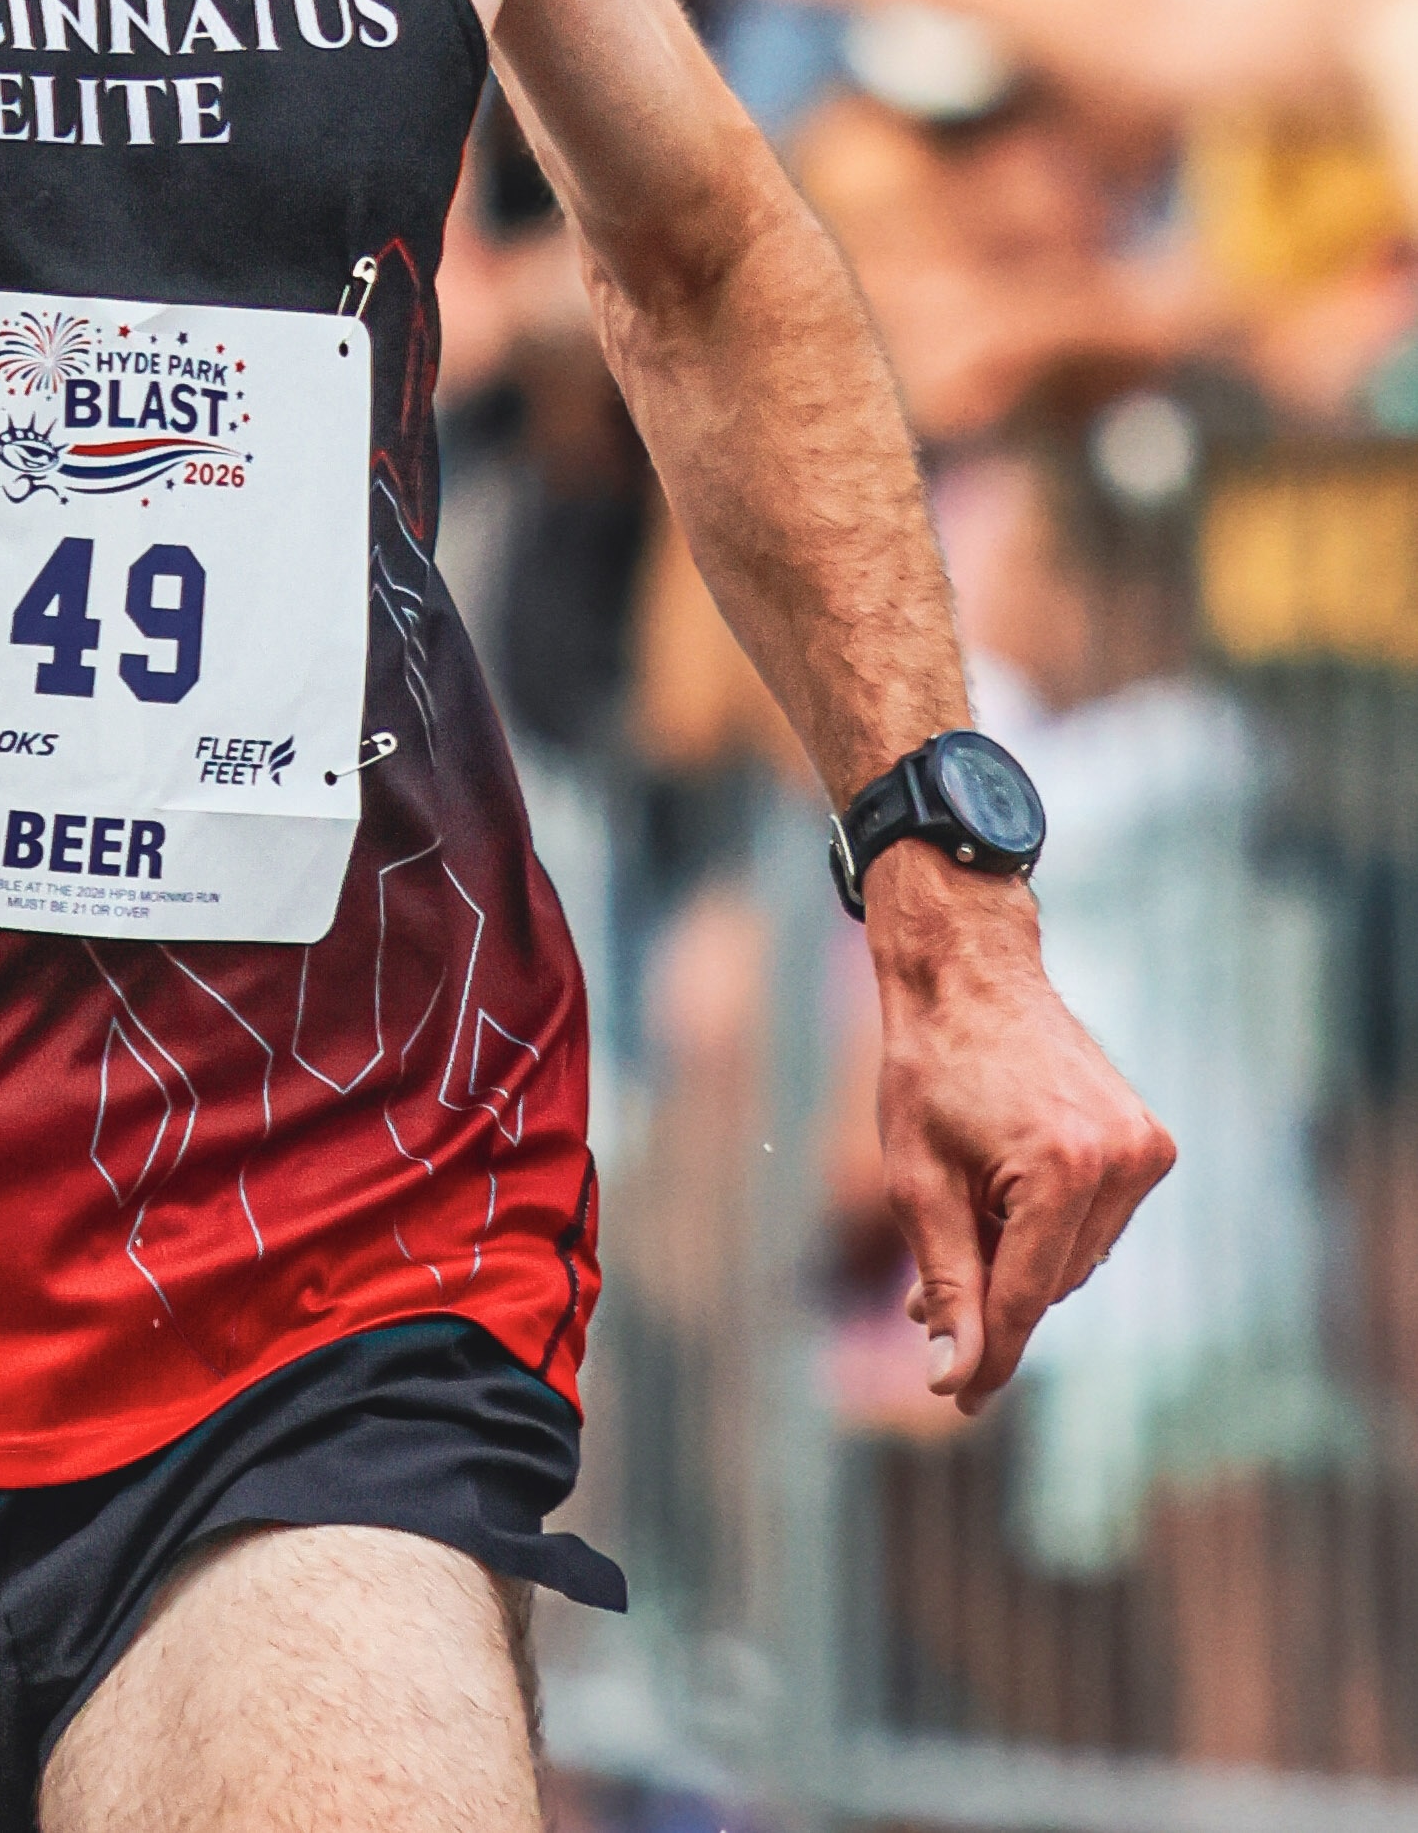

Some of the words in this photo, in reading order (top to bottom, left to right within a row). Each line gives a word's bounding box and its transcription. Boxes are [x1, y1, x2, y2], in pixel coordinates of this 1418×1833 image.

[96, 351, 161, 375] HYDE
[168, 354, 228, 387] PARK
[64, 378, 229, 437] BLAST
[184, 461, 246, 488] 2026
[10, 536, 206, 705] 49
[195, 736, 273, 762] FLEET
[200, 761, 264, 786] FEET
[2, 809, 166, 879] BEER
[25, 880, 42, 893] AT
[47, 882, 72, 896] THE
[196, 891, 221, 903] RUN
[7, 896, 45, 911] MUST
[49, 900, 68, 913] BE
[91, 903, 110, 916] OR
[114, 905, 150, 919] OVER
